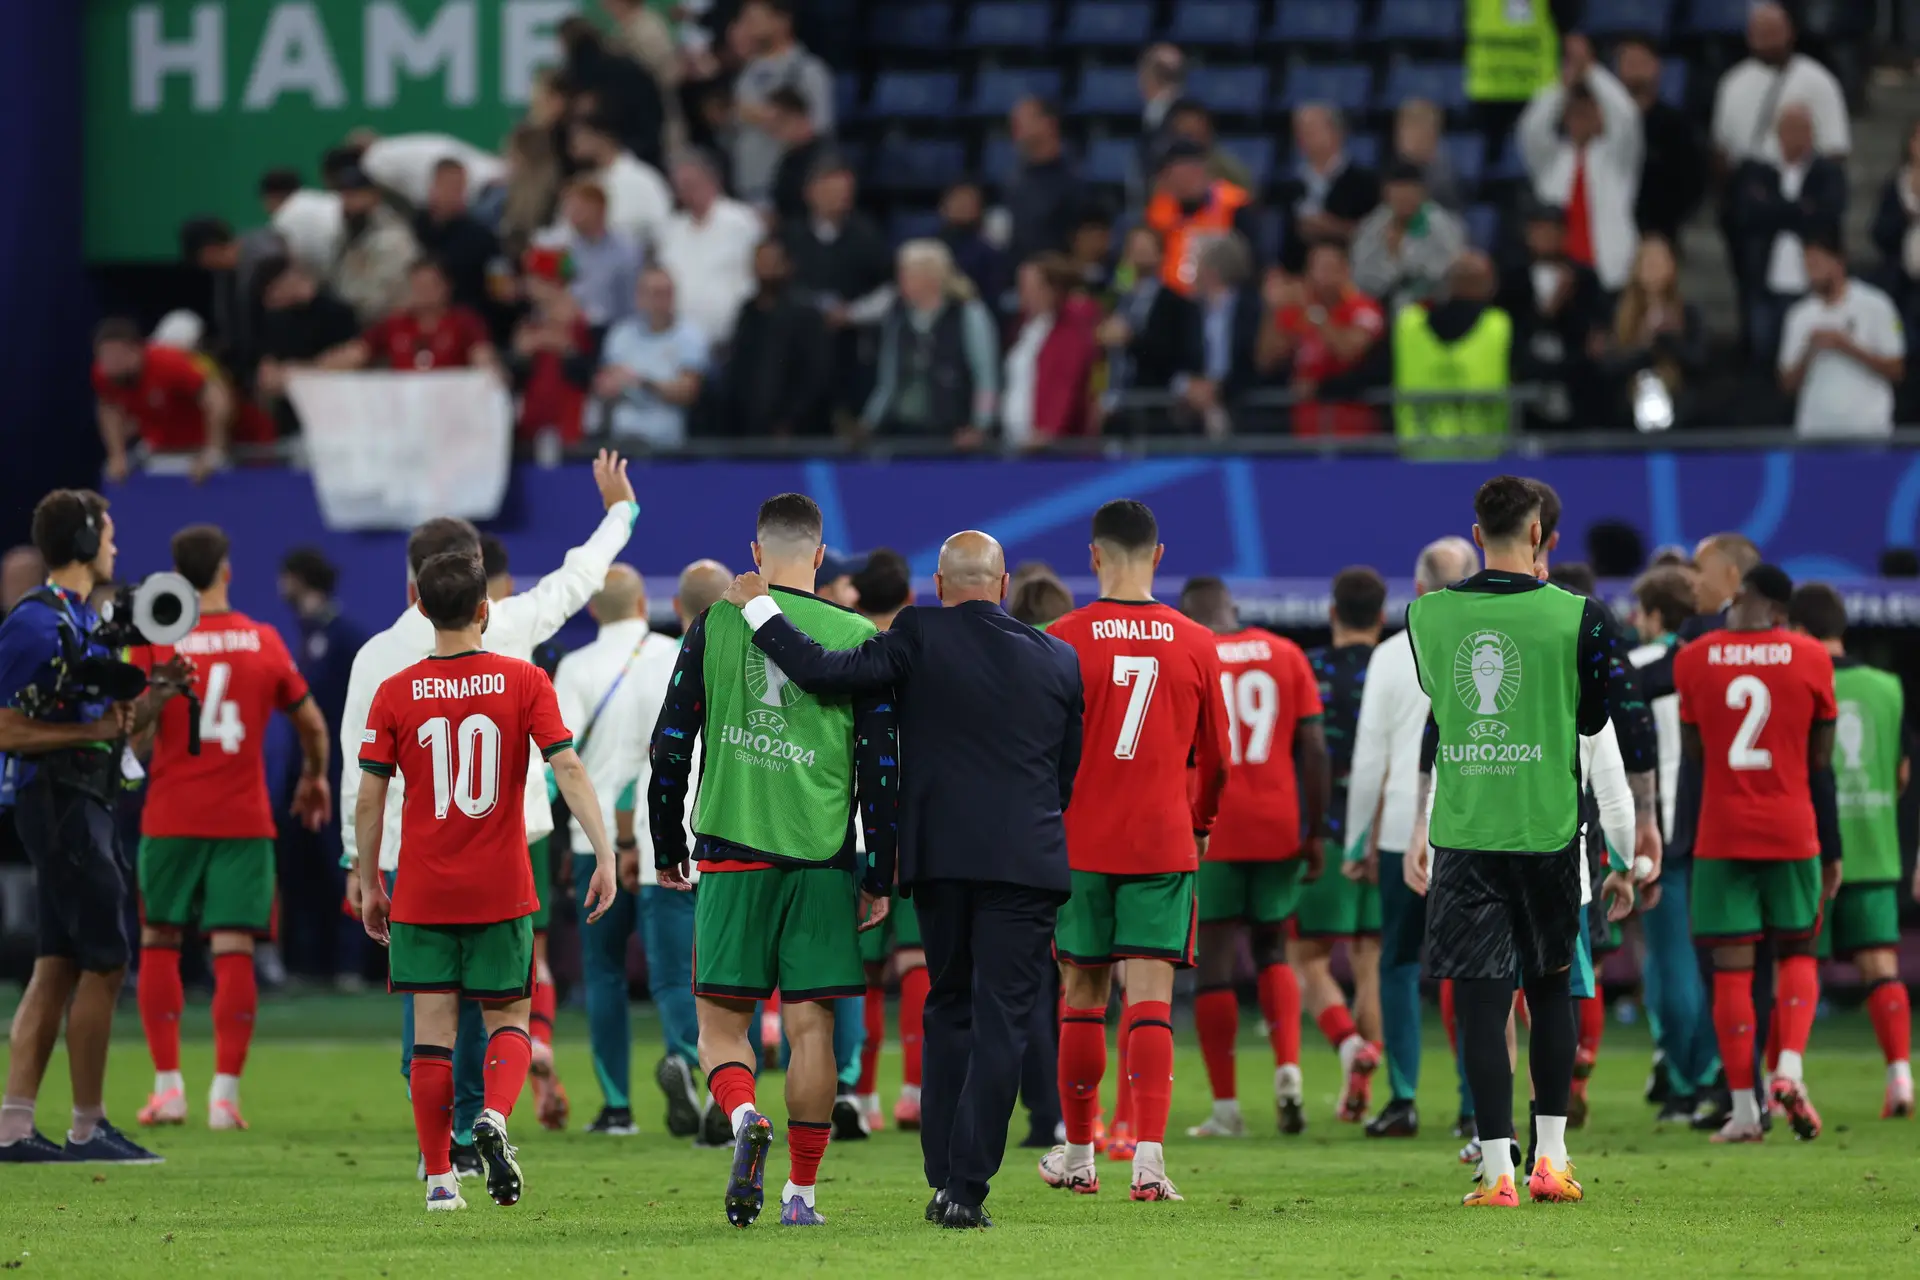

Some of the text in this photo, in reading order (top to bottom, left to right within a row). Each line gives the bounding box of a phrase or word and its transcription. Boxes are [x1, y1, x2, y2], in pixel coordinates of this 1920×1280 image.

[1091, 618, 1174, 642] RONALDO
[412, 672, 506, 701] BERNARDO
[199, 661, 246, 755] 4
[1112, 655, 1159, 760] 7
[1219, 669, 1279, 766] 19
[747, 712, 786, 734] UEFA
[1468, 723, 1506, 739] UEFA
[1725, 674, 1773, 771] 2
[417, 713, 501, 820] 10
[734, 749, 789, 773] GERMANY
[1459, 764, 1517, 777] GERMANY
